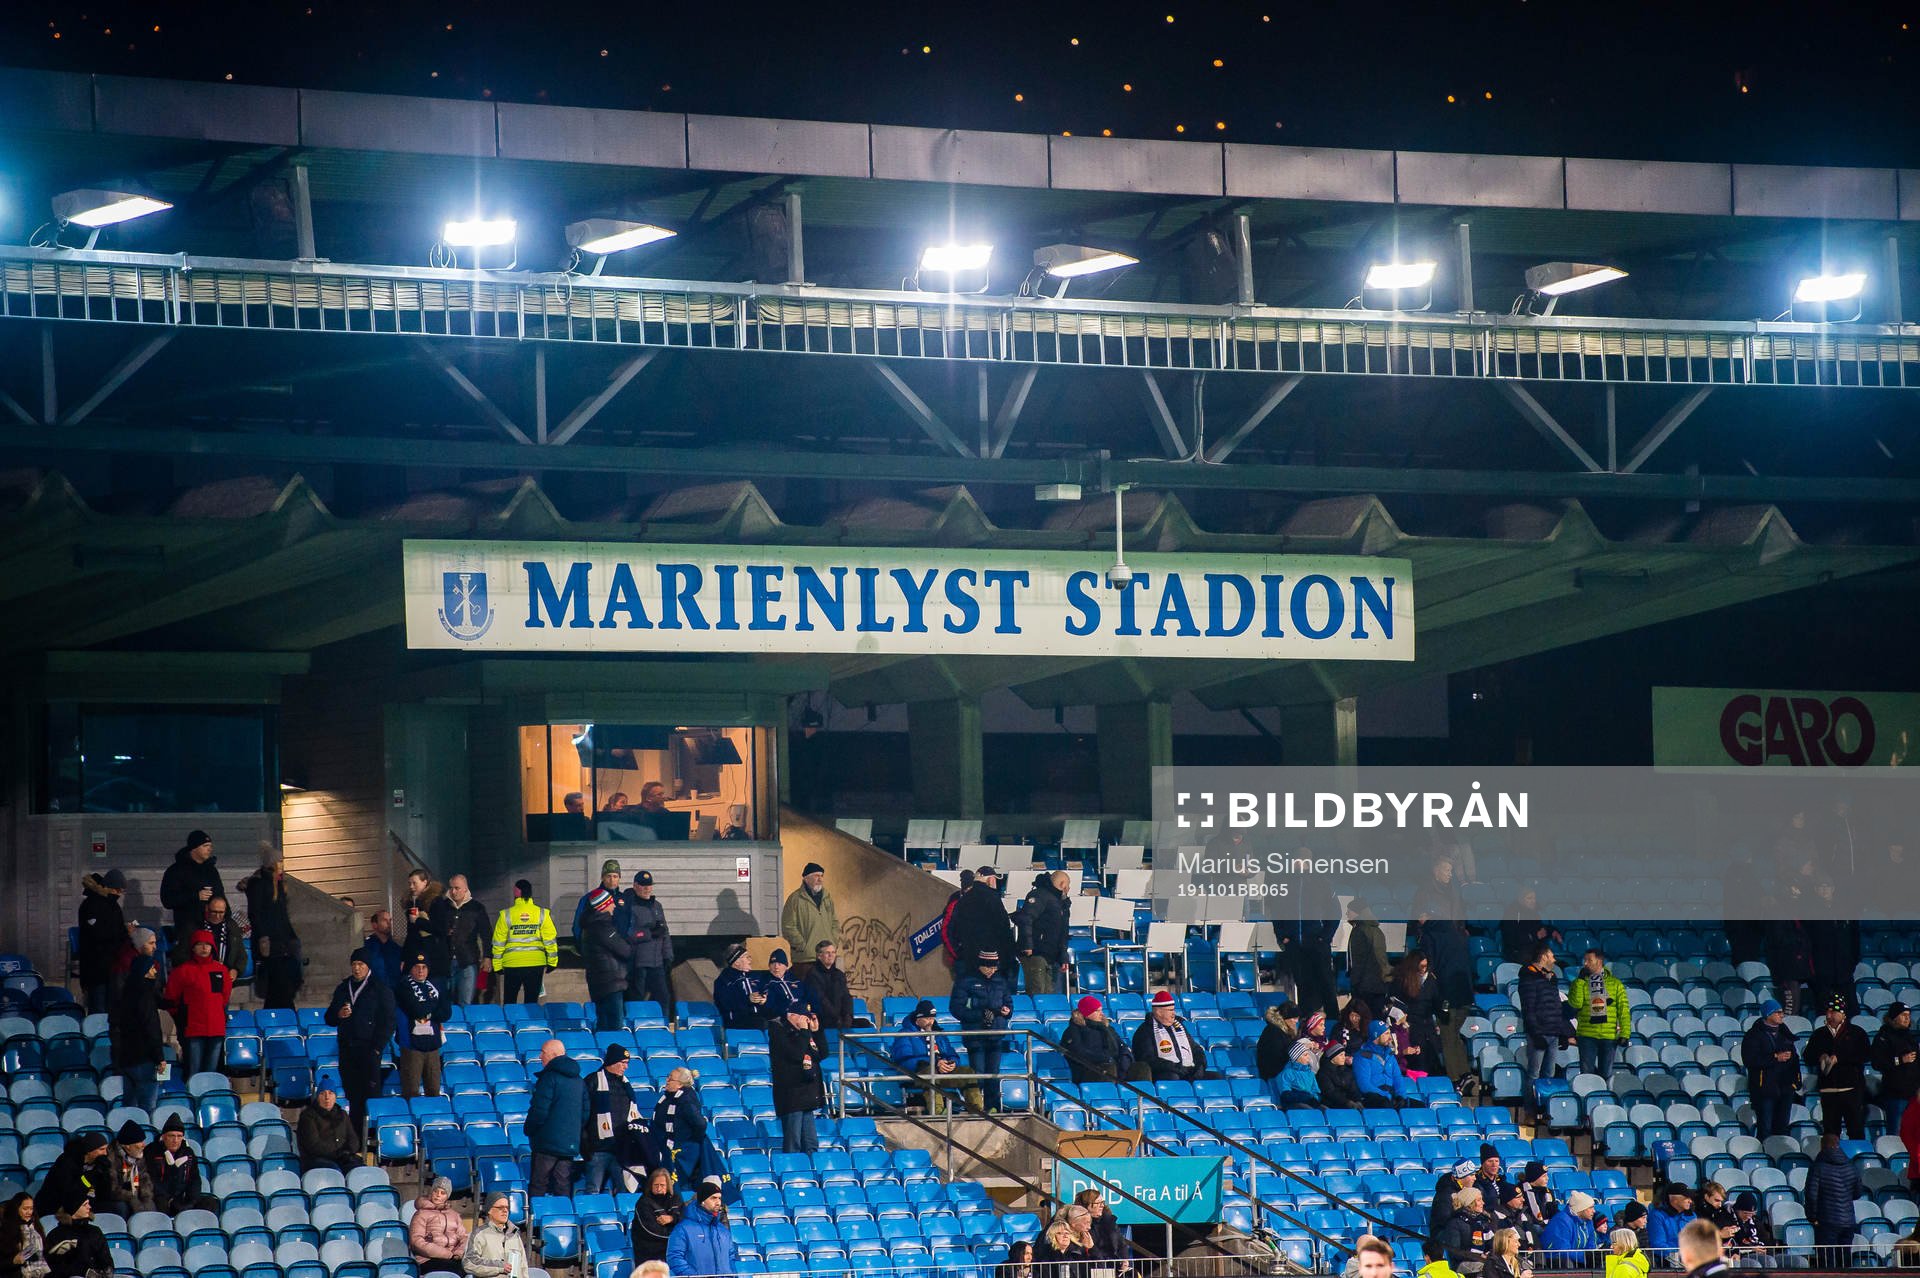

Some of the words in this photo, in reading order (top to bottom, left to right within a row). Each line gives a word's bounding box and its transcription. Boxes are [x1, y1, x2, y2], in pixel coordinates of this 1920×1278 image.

[522, 561, 1030, 634] MARIENLYST
[1064, 569, 1396, 641] STADION
[1719, 694, 1876, 769] GARO
[913, 918, 943, 946] TOALETT
[1133, 1185, 1157, 1201] Fra
[1160, 1185, 1171, 1201] A
[1174, 1183, 1189, 1201] til
[1191, 1180, 1203, 1201] Å
